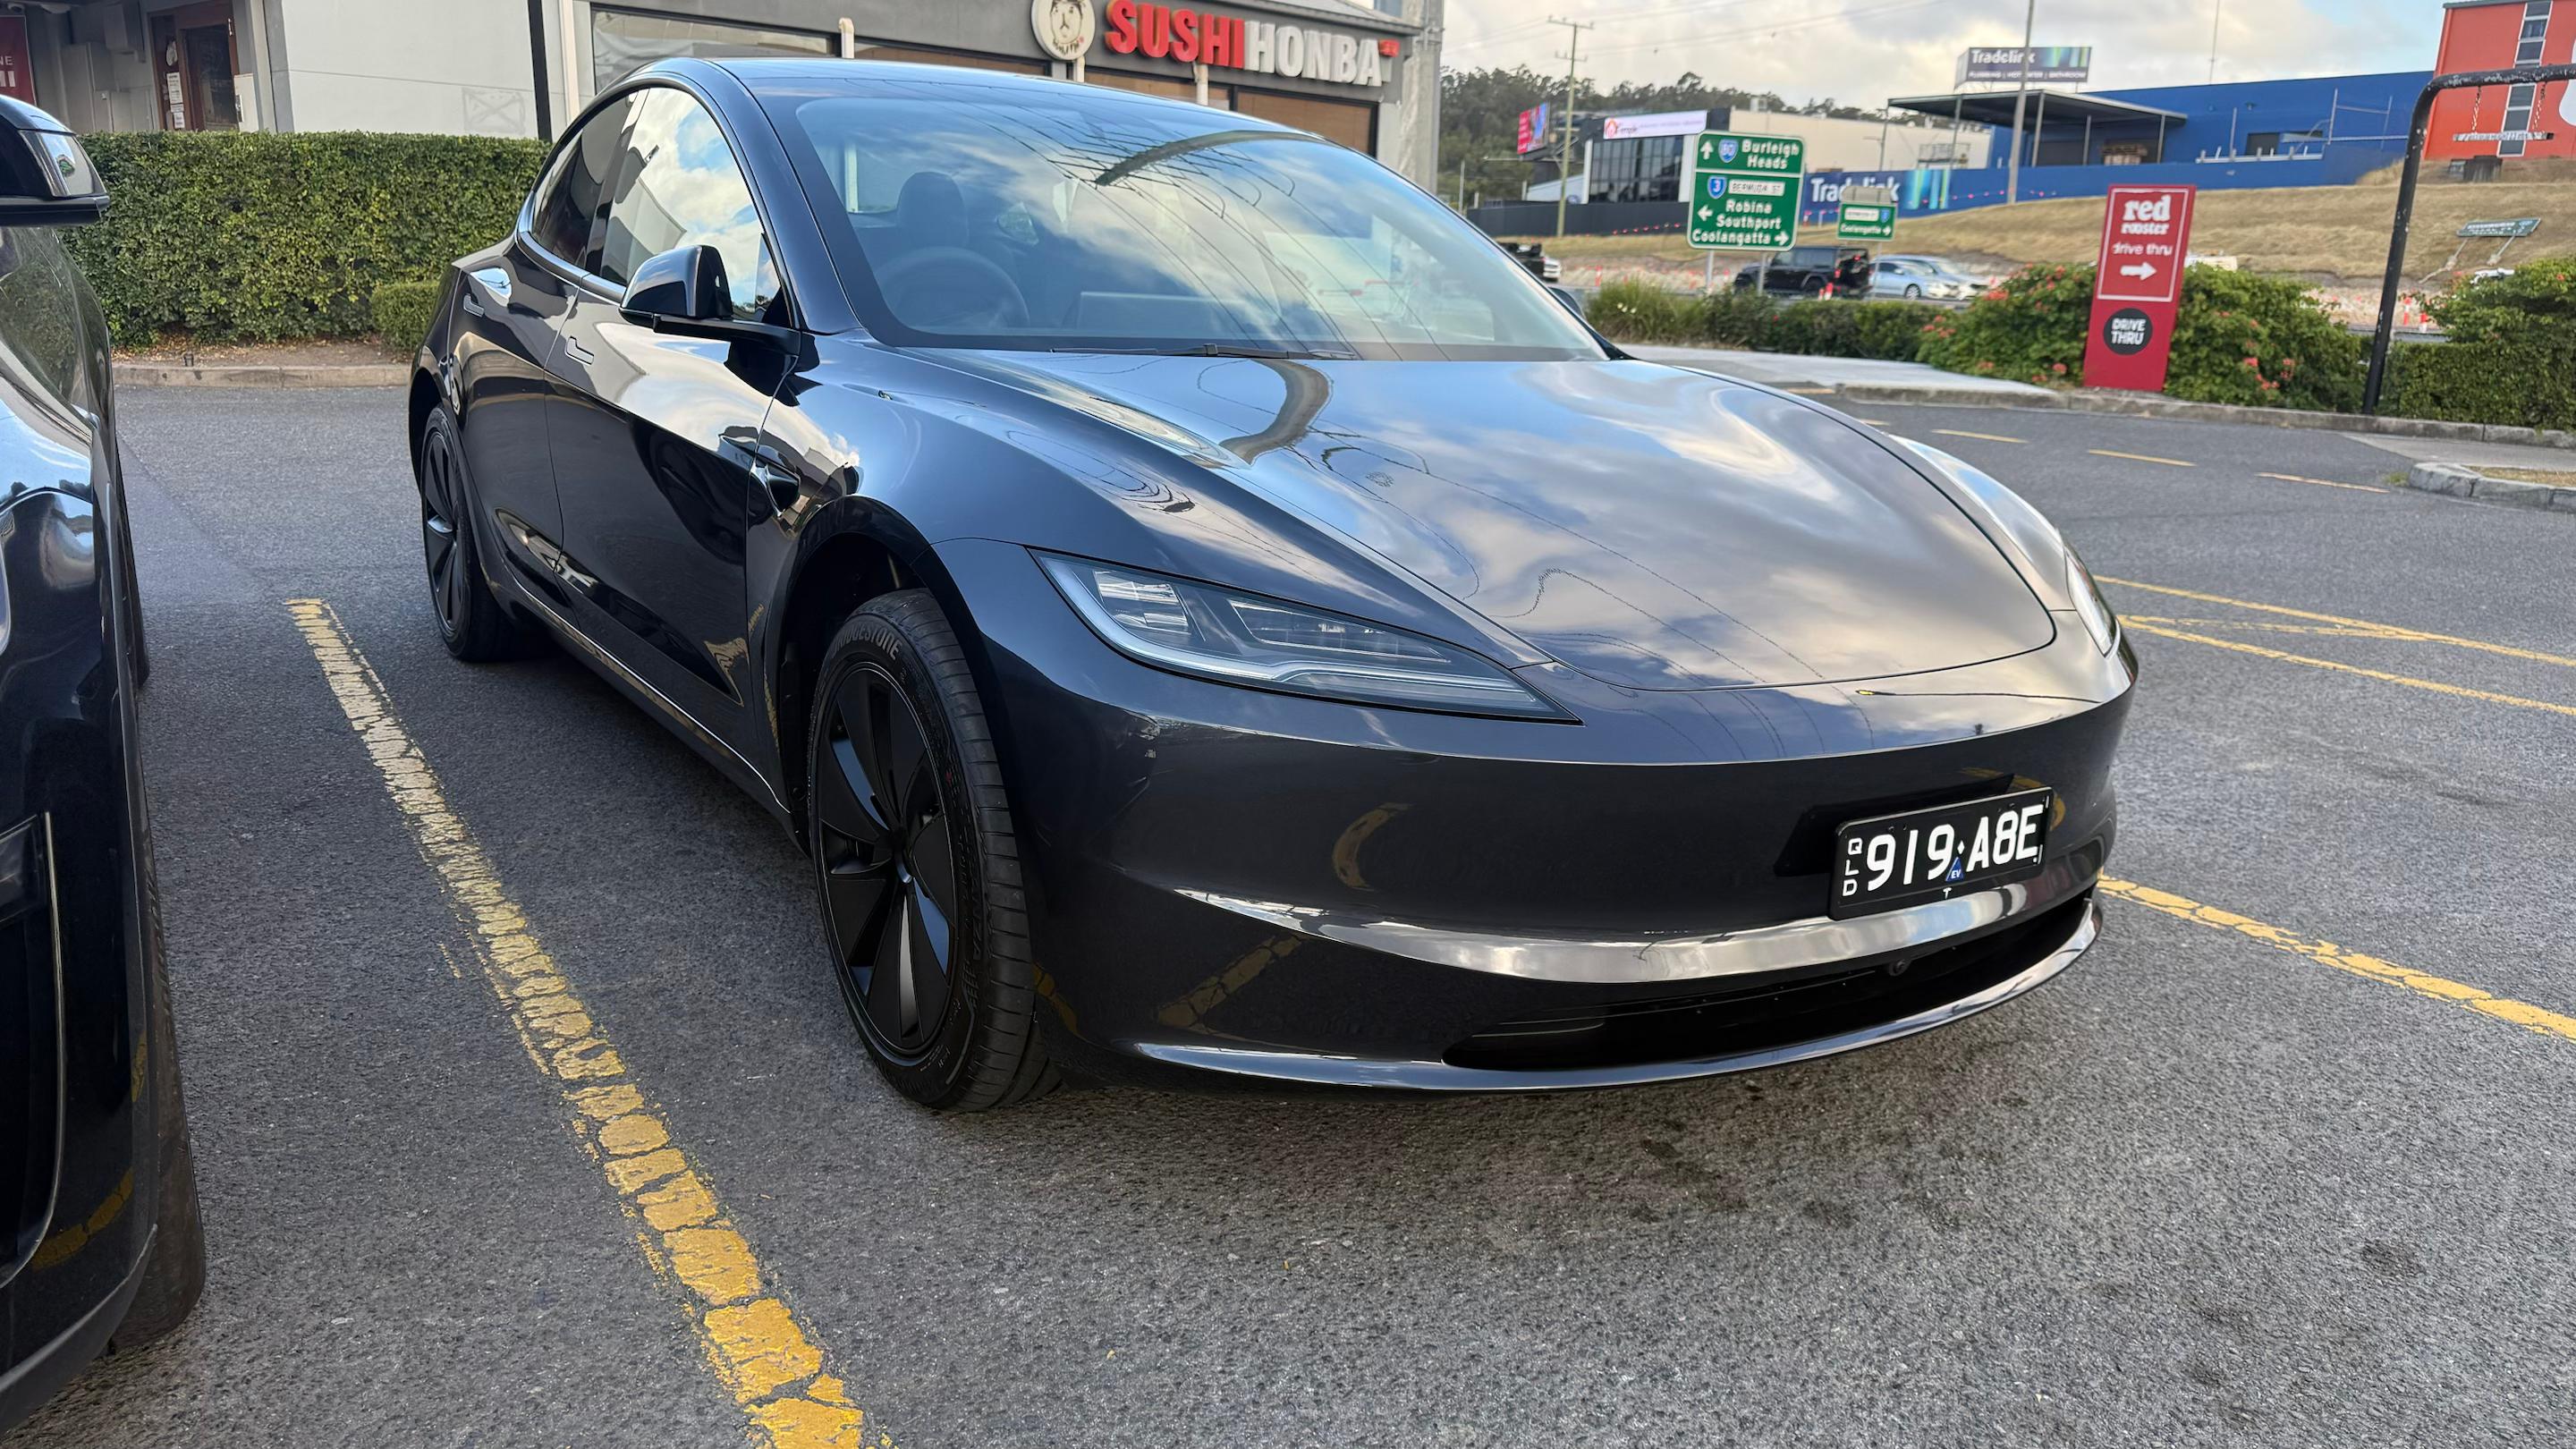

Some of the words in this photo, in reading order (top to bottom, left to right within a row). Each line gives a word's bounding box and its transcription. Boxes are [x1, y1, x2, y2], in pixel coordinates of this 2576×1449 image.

[1105, 0, 1245, 69] SUSHI
[1244, 21, 1383, 87] HONBA
[1741, 140, 1800, 158] Burleigh
[1747, 154, 1788, 169] Heads
[1713, 180, 1722, 192] 3
[1810, 177, 1901, 202] Tradk
[1725, 199, 1772, 214] Robina
[2122, 194, 2172, 222] red
[1716, 214, 1782, 231] Southport
[2121, 222, 2170, 235] rooster
[1691, 228, 1771, 247] Coolangatta
[2112, 242, 2144, 255] drive
[2146, 242, 2173, 256] thru
[2112, 318, 2147, 332] DRIVE
[2111, 331, 2145, 345] THRU
[1843, 837, 1862, 897] QLD
[1951, 869, 1962, 879] EV
